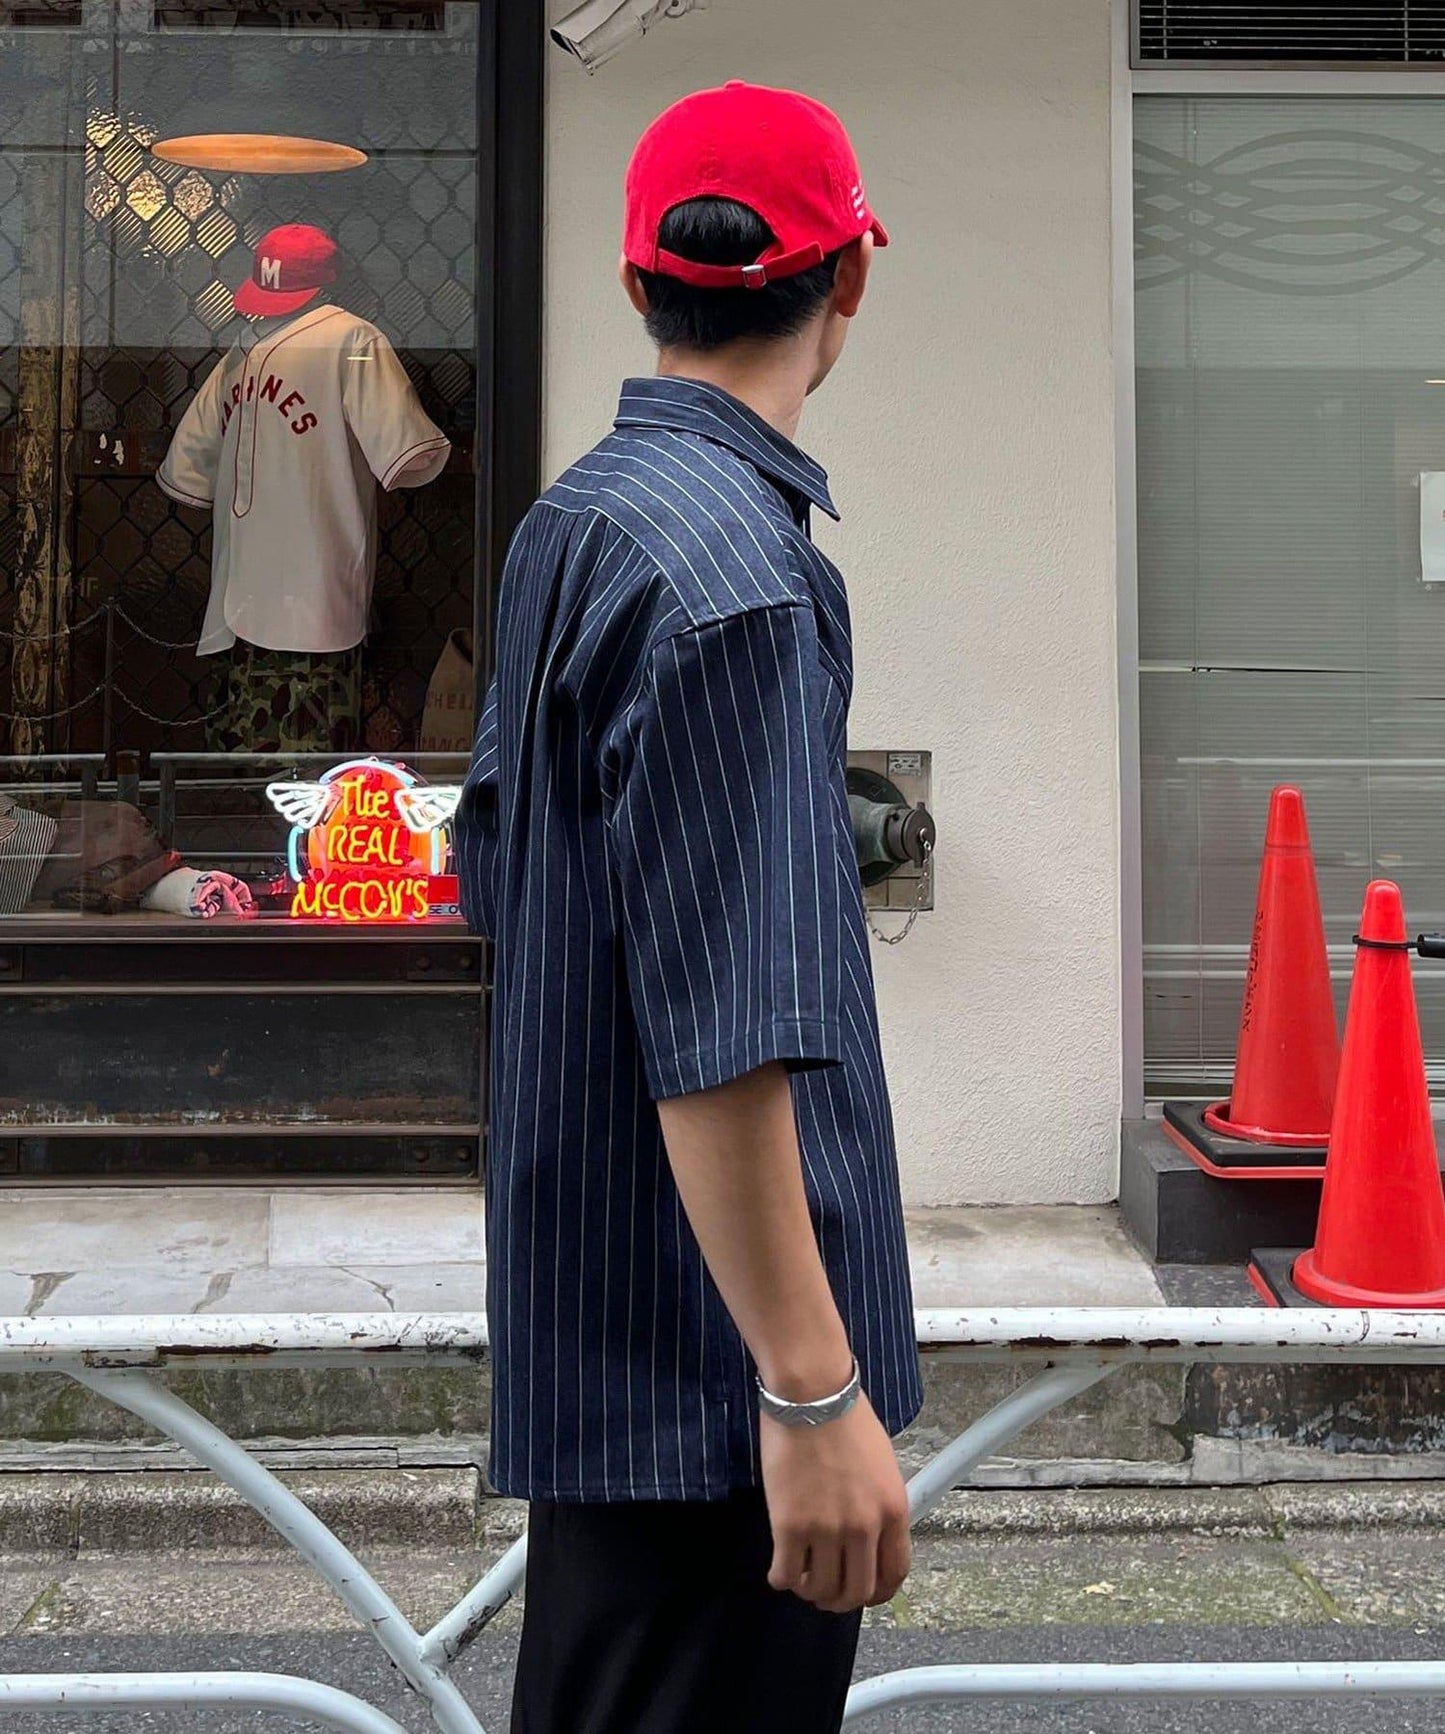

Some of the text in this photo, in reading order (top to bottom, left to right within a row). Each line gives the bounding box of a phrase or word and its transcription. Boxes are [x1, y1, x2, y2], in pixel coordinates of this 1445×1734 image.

[261, 256, 281, 289] M
[338, 774, 390, 818] The
[327, 825, 403, 865] REAL
